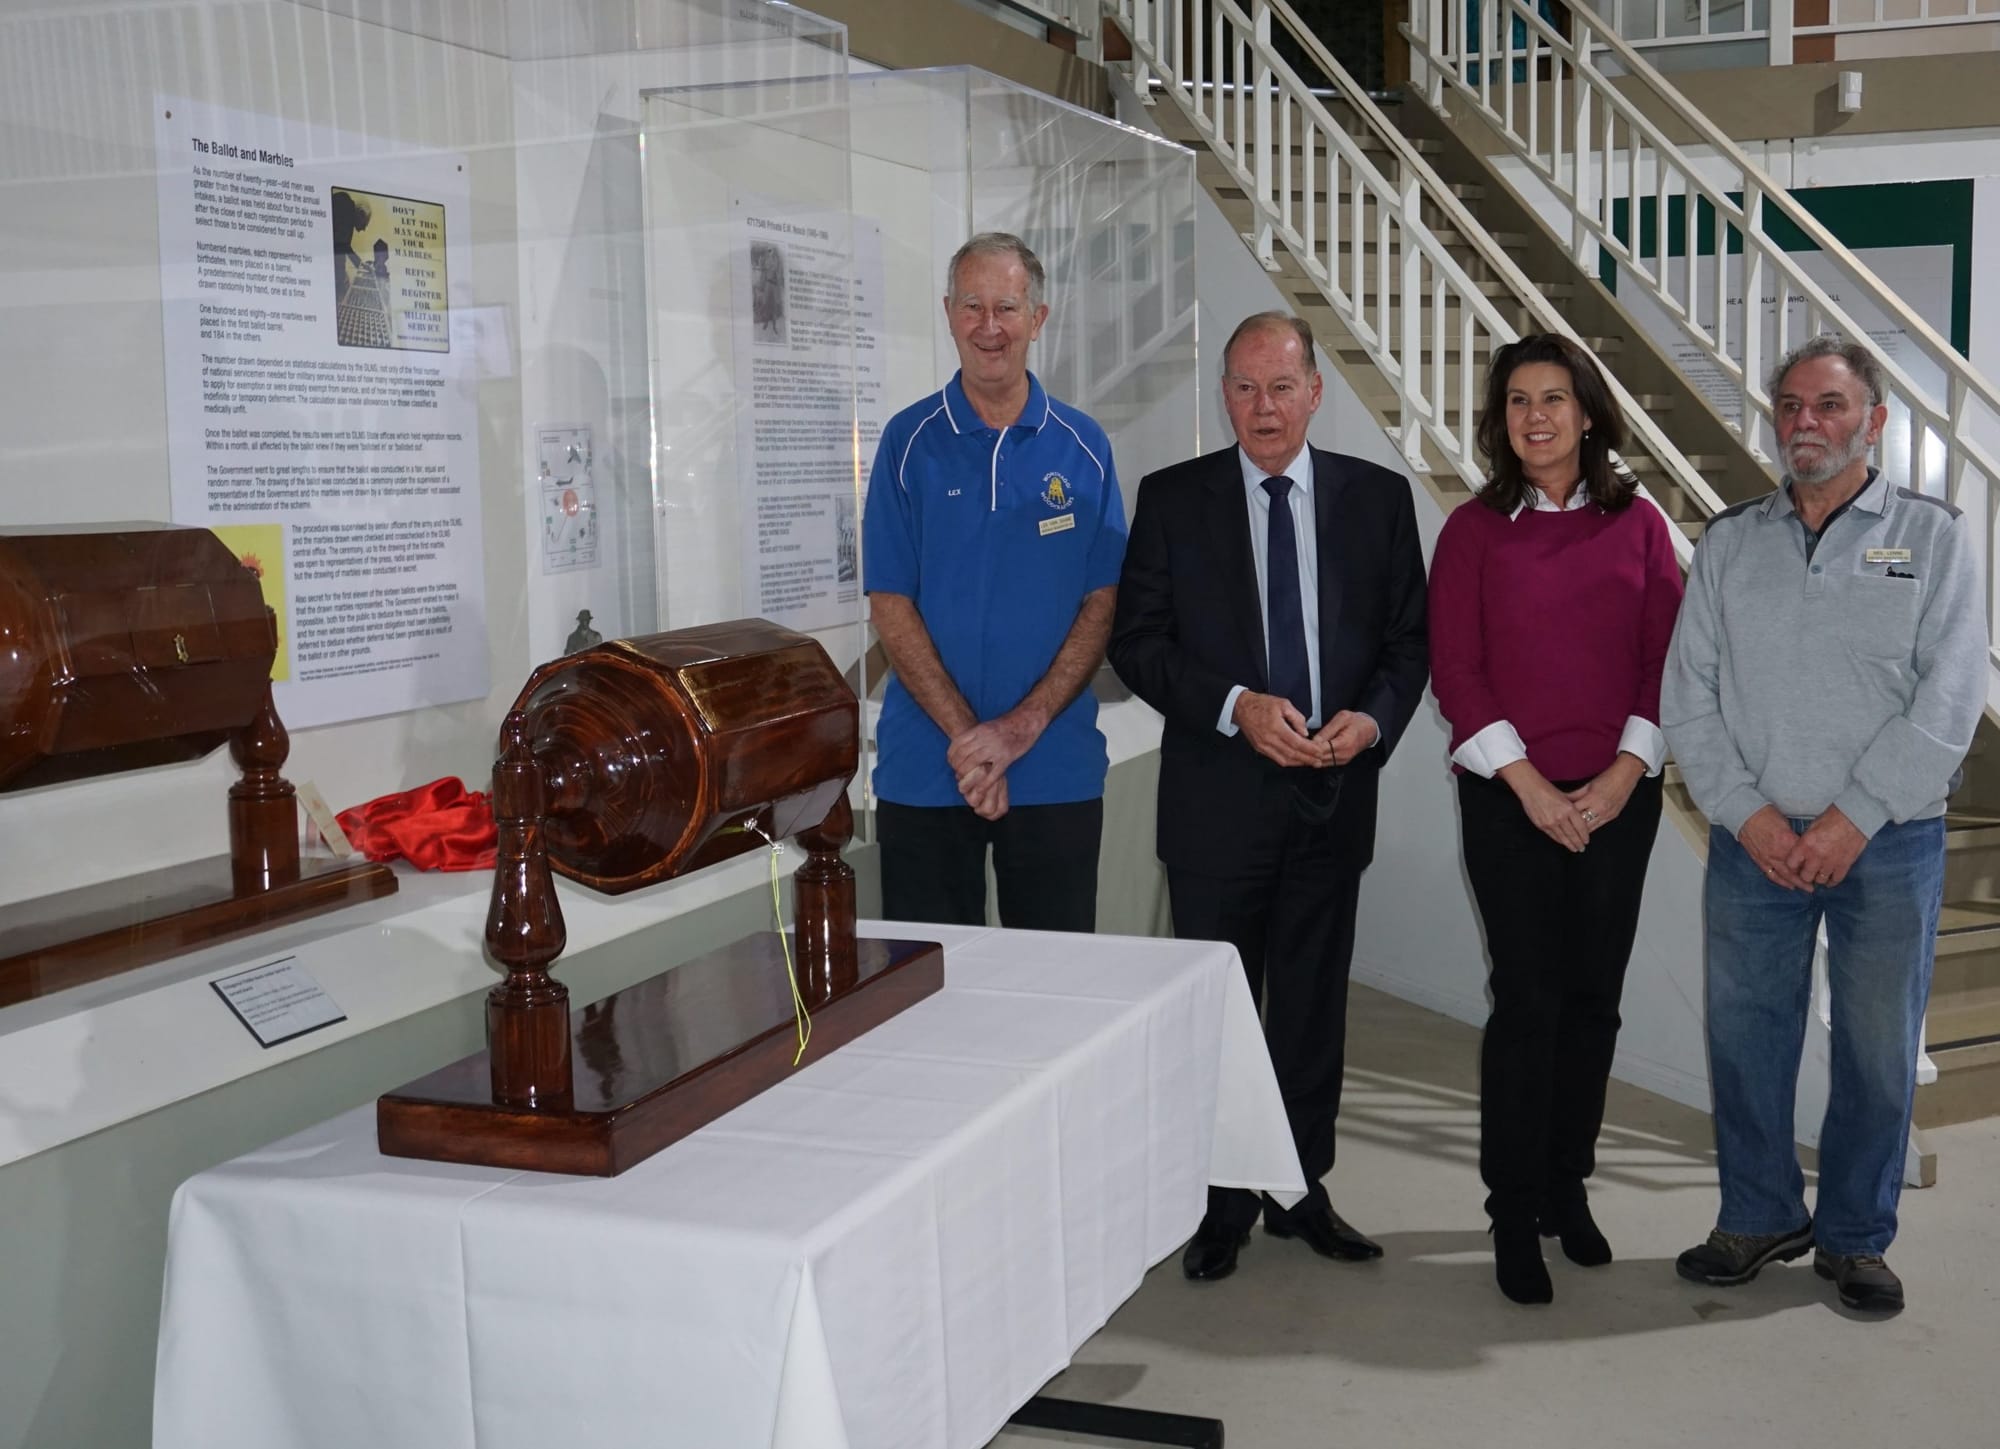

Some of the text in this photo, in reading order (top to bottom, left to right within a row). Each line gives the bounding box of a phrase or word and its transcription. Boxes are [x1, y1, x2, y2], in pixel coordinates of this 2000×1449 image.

[192, 138, 293, 167] The Ballot and Marbles
[202, 166, 211, 176] the
[213, 170, 234, 180] number
[291, 182, 302, 190] men
[304, 184, 314, 192] was
[194, 179, 214, 189] greater
[216, 181, 228, 191] than
[230, 183, 239, 193] the
[241, 186, 261, 196] number
[263, 189, 283, 199] needed
[293, 192, 301, 202] the
[303, 196, 320, 205] annual
[224, 194, 239, 205] ballot
[241, 199, 252, 207] was
[254, 199, 265, 209] held
[267, 201, 281, 211] about
[284, 203, 293, 213] four
[310, 208, 326, 218] weeks
[393, 206, 415, 216] DON'T
[195, 203, 208, 214] after
[210, 205, 219, 215] the
[221, 207, 235, 217] close
[244, 211, 256, 220] each
[259, 213, 288, 225] registration
[290, 217, 306, 228] period
[196, 216, 212, 227] select
[214, 218, 229, 229] those
[247, 223, 276, 234] considered
[287, 227, 296, 237] call
[402, 218, 438, 229] LET THIS
[394, 227, 437, 240] MAN GRAB
[403, 239, 424, 248] YOUR
[197, 241, 226, 253] Numbered
[254, 248, 267, 258] each
[269, 251, 301, 263] representing
[303, 252, 312, 262] two
[230, 259, 243, 267] were
[245, 259, 263, 270] placed
[204, 267, 244, 279] predetermined
[247, 272, 267, 281] number
[276, 274, 296, 285] marbles
[299, 278, 311, 286] were
[405, 267, 435, 278] REFUSE
[199, 279, 216, 289] drawn
[218, 281, 244, 294] randomly
[416, 279, 425, 287] TO
[402, 288, 441, 300] REGISTER
[414, 301, 430, 310] FOR
[200, 303, 211, 313] One
[213, 304, 236, 315] hundred
[238, 307, 248, 316] and
[282, 311, 302, 321] marbles
[304, 314, 317, 322] were
[404, 311, 441, 322] MILITARY
[200, 317, 219, 329] placed
[228, 319, 236, 328] the
[238, 319, 249, 329] first
[251, 320, 265, 330] ballot
[408, 323, 439, 332] SERVICE
[201, 330, 211, 339] and
[214, 330, 224, 339] 184
[233, 331, 241, 340] the
